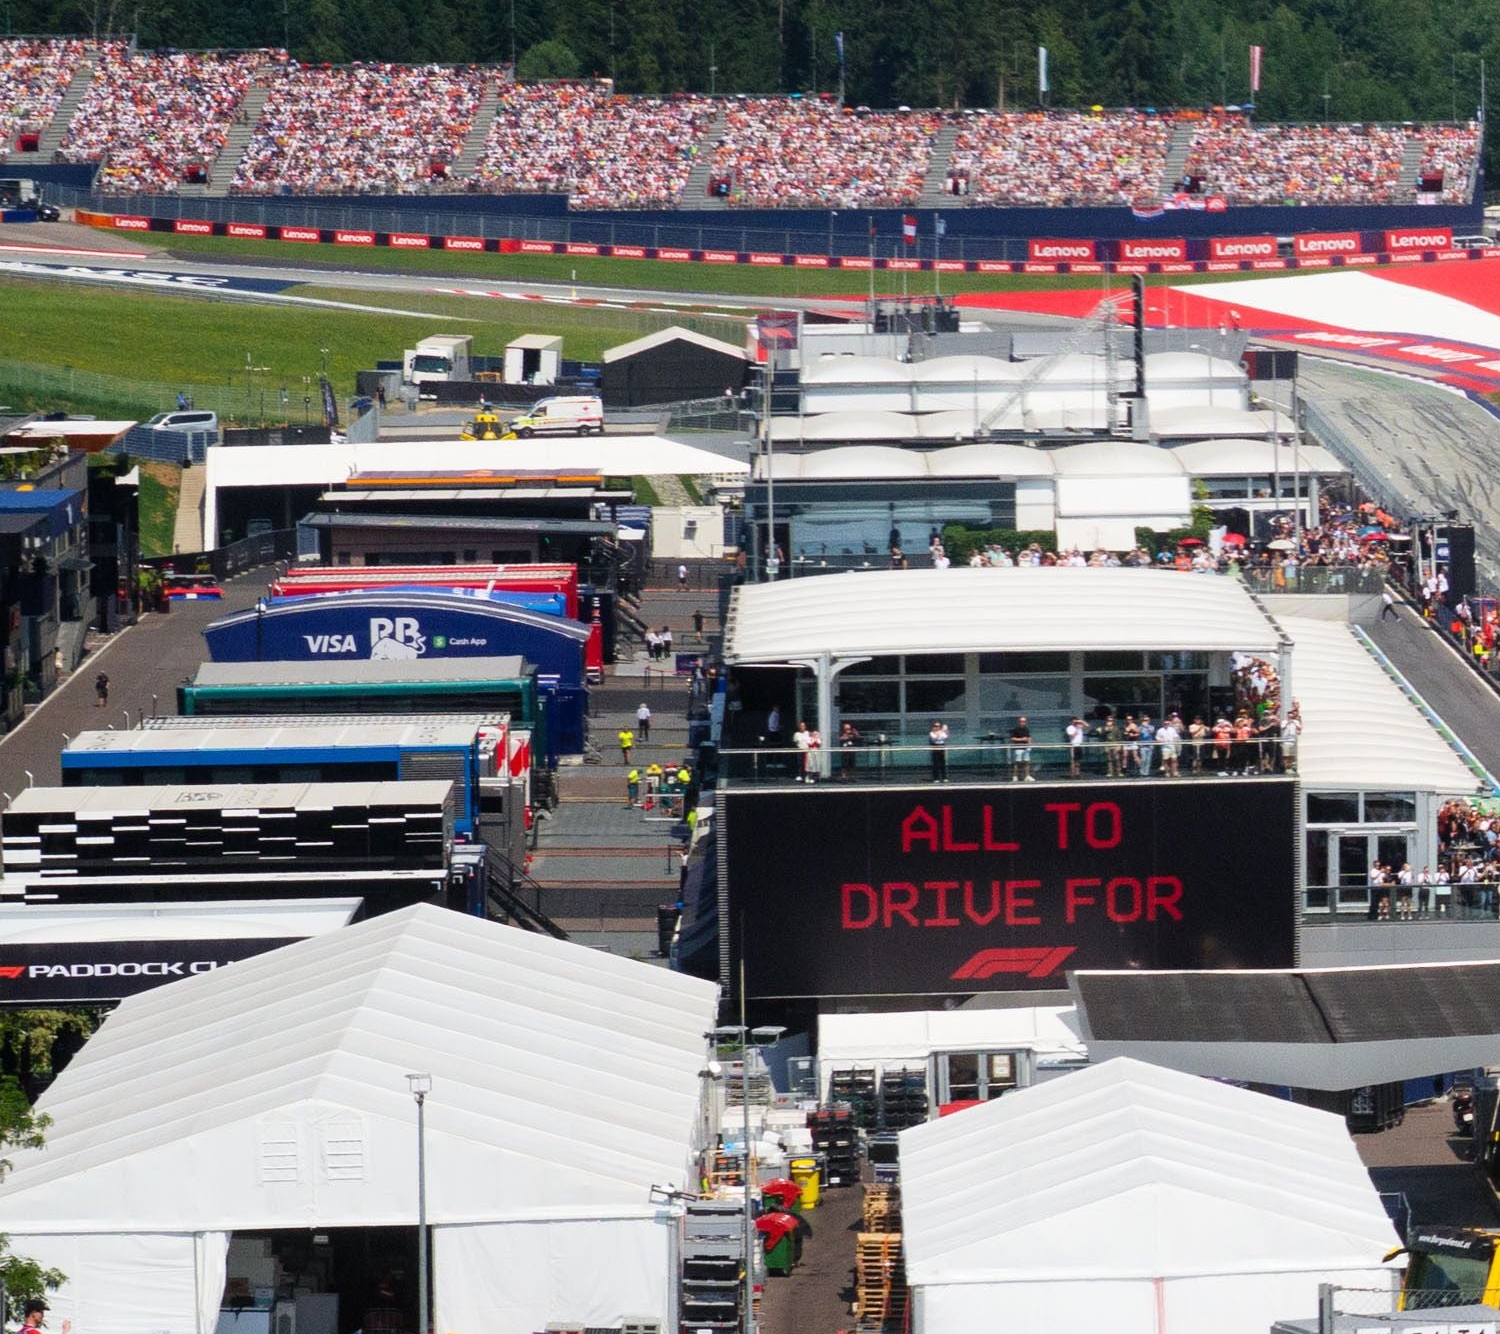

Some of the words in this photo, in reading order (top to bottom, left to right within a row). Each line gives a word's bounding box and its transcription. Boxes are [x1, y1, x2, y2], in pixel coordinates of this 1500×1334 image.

[1300, 238, 1355, 251] Lenovo
[1391, 233, 1446, 248] Lenovo
[1034, 243, 1090, 257] Lenovo
[1125, 244, 1181, 258] Lenovo
[1216, 241, 1272, 255] Lenovo
[303, 635, 357, 653] VISA
[450, 638, 469, 646] Cash
[470, 638, 487, 647] App
[902, 805, 1020, 853] ALL
[1045, 802, 1123, 850] TO
[840, 880, 1043, 929] DRIVE
[1065, 876, 1184, 924] FOR
[29, 961, 184, 978] PADDOCK
